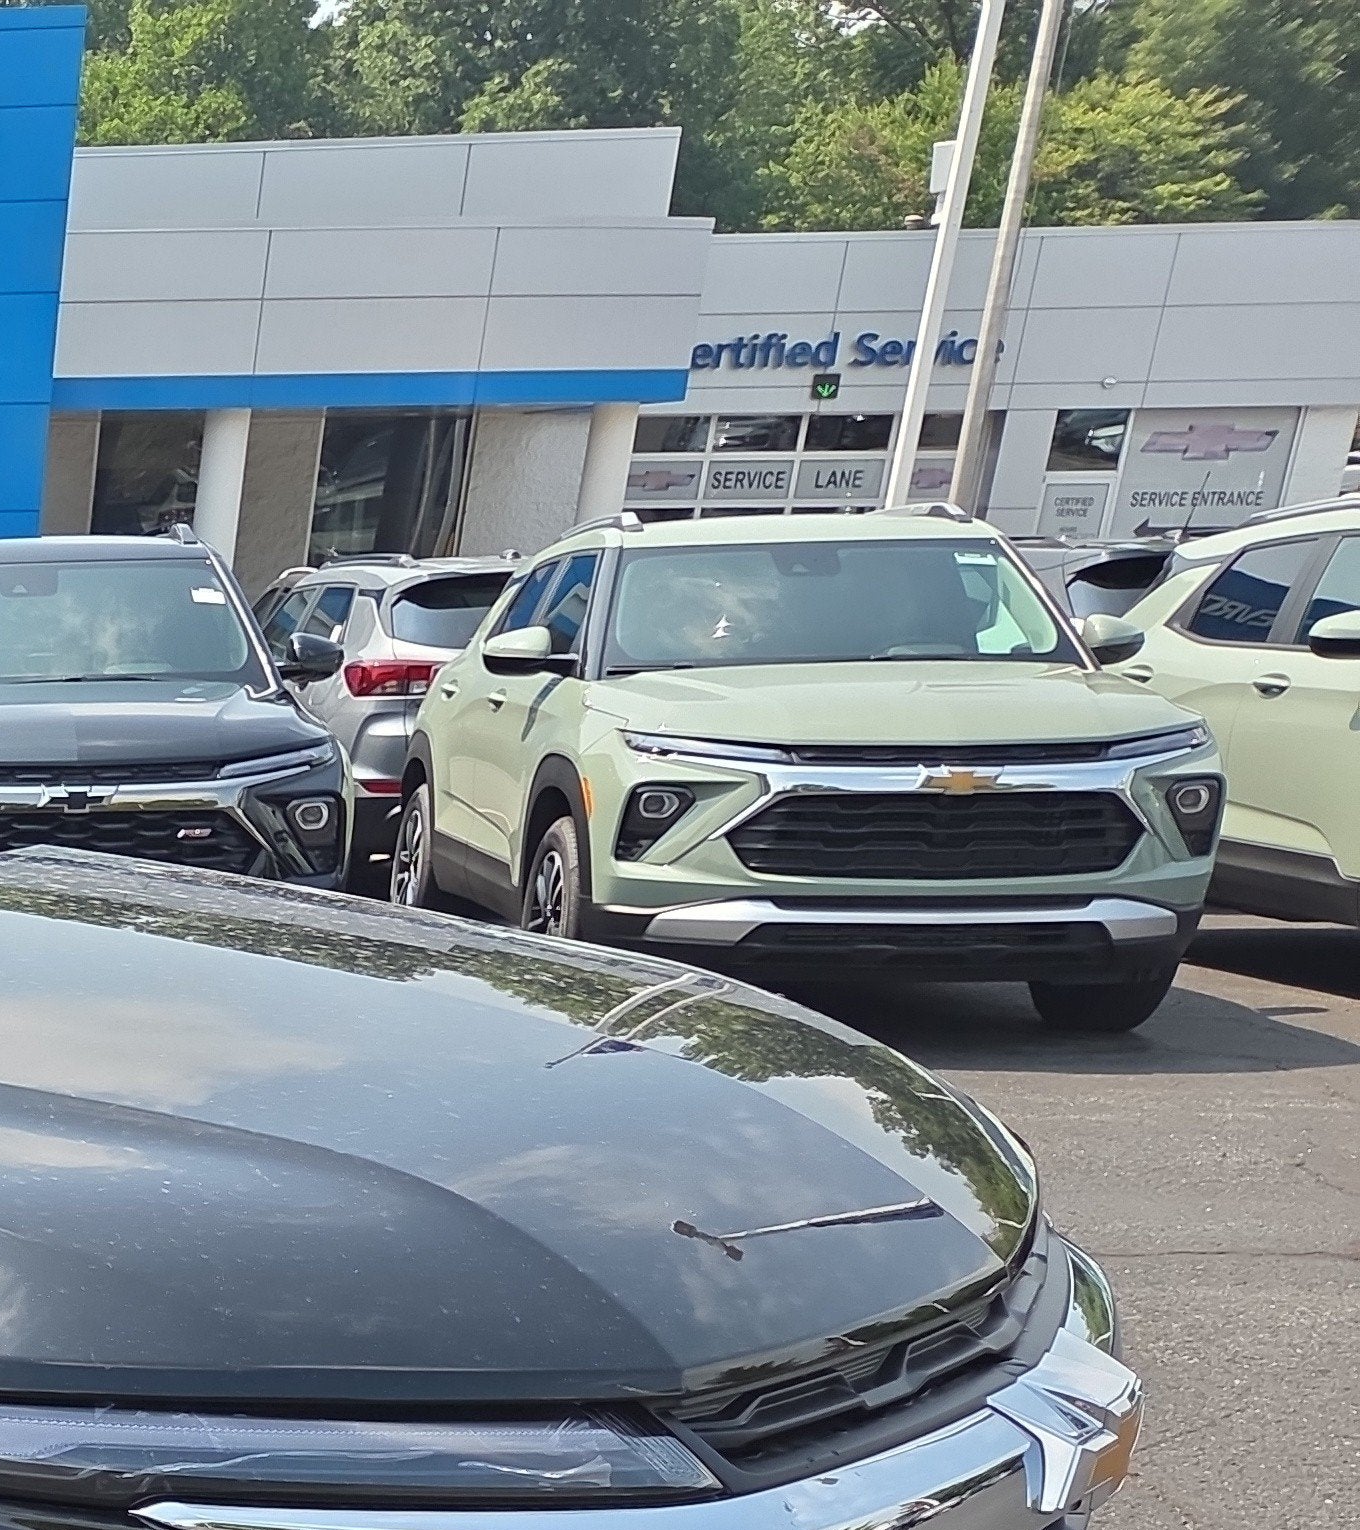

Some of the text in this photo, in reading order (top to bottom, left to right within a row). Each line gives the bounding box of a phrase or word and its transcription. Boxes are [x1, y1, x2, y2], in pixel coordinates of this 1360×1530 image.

[691, 330, 1005, 369] ertified Seric
[711, 469, 864, 490] SERVICE LANE
[1130, 490, 1265, 507] SERVICE ENTRANCE
